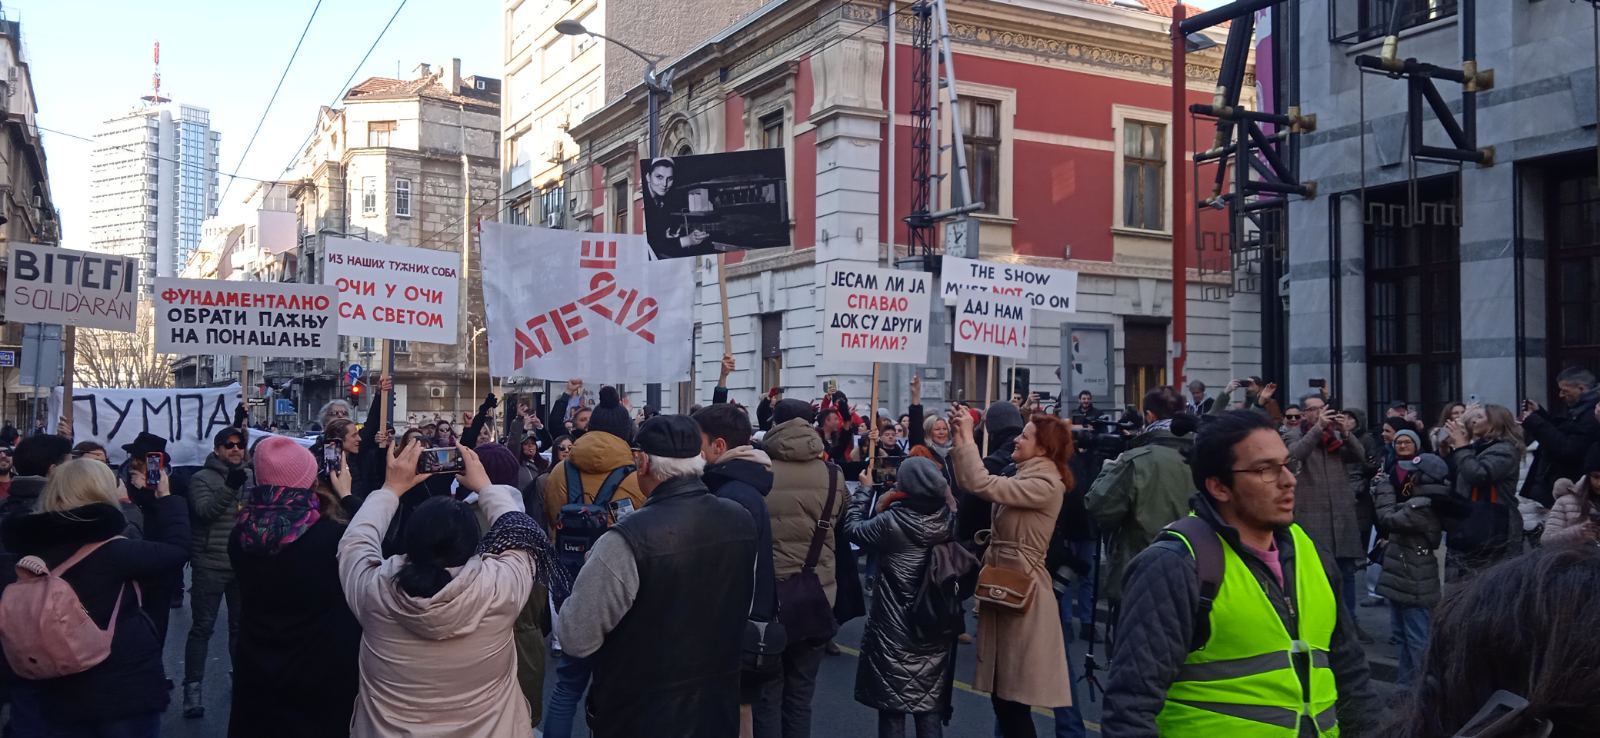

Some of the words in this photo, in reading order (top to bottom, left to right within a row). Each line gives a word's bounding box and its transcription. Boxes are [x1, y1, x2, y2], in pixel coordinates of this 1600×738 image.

[328, 253, 343, 264] ИЗ
[347, 255, 385, 269] НАШИХ
[389, 260, 430, 274] ТУЖНИХ
[431, 266, 457, 279] СОБА
[970, 263, 995, 279] THE
[1004, 268, 1051, 286] SHOW
[335, 277, 376, 297] ОЧИ
[385, 283, 397, 298] У
[404, 286, 443, 304] ОЧИ
[831, 271, 878, 290] ЈЕСАМ
[885, 276, 904, 292] ЛИ
[908, 278, 925, 294] ЈА
[15, 286, 131, 320] SOLIDARAN
[161, 288, 330, 311] ФУНДАМЕНТАЛНО
[847, 294, 909, 311] СПАВАО
[963, 299, 989, 315] ДАЈ
[995, 302, 1023, 321] НАМ
[1049, 295, 1069, 308] ON
[167, 308, 247, 325] ОБРАТИ
[259, 311, 328, 329] ПАЖЊУ
[338, 302, 366, 320] СА
[372, 306, 443, 328] СВЕТОМ
[830, 313, 859, 329] ДОК
[861, 314, 879, 330] СУ
[881, 316, 922, 333] ДРУГИ
[171, 327, 199, 343] НА
[206, 328, 321, 348] ПОНАШАЊЕ
[841, 333, 908, 350] ПАТИЛИ?
